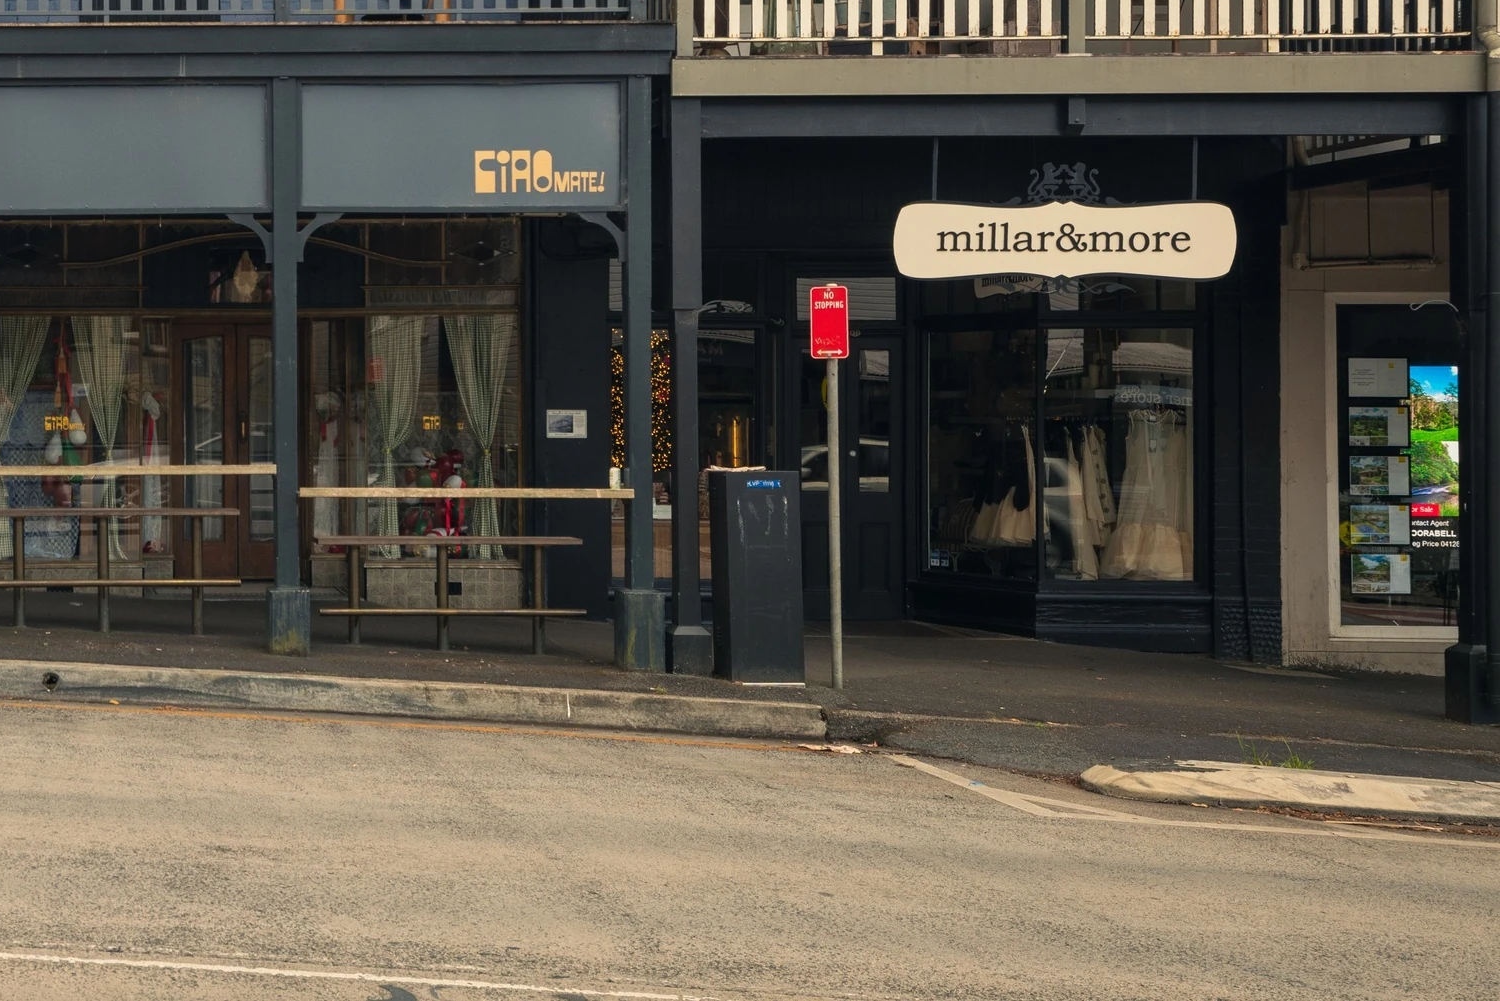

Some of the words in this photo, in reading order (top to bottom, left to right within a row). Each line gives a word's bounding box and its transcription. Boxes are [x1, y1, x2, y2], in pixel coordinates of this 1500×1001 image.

[554, 171, 605, 193] MATE!
[936, 222, 1191, 253] millar&more
[823, 291, 834, 299] NO
[814, 301, 844, 309] STOPPING
